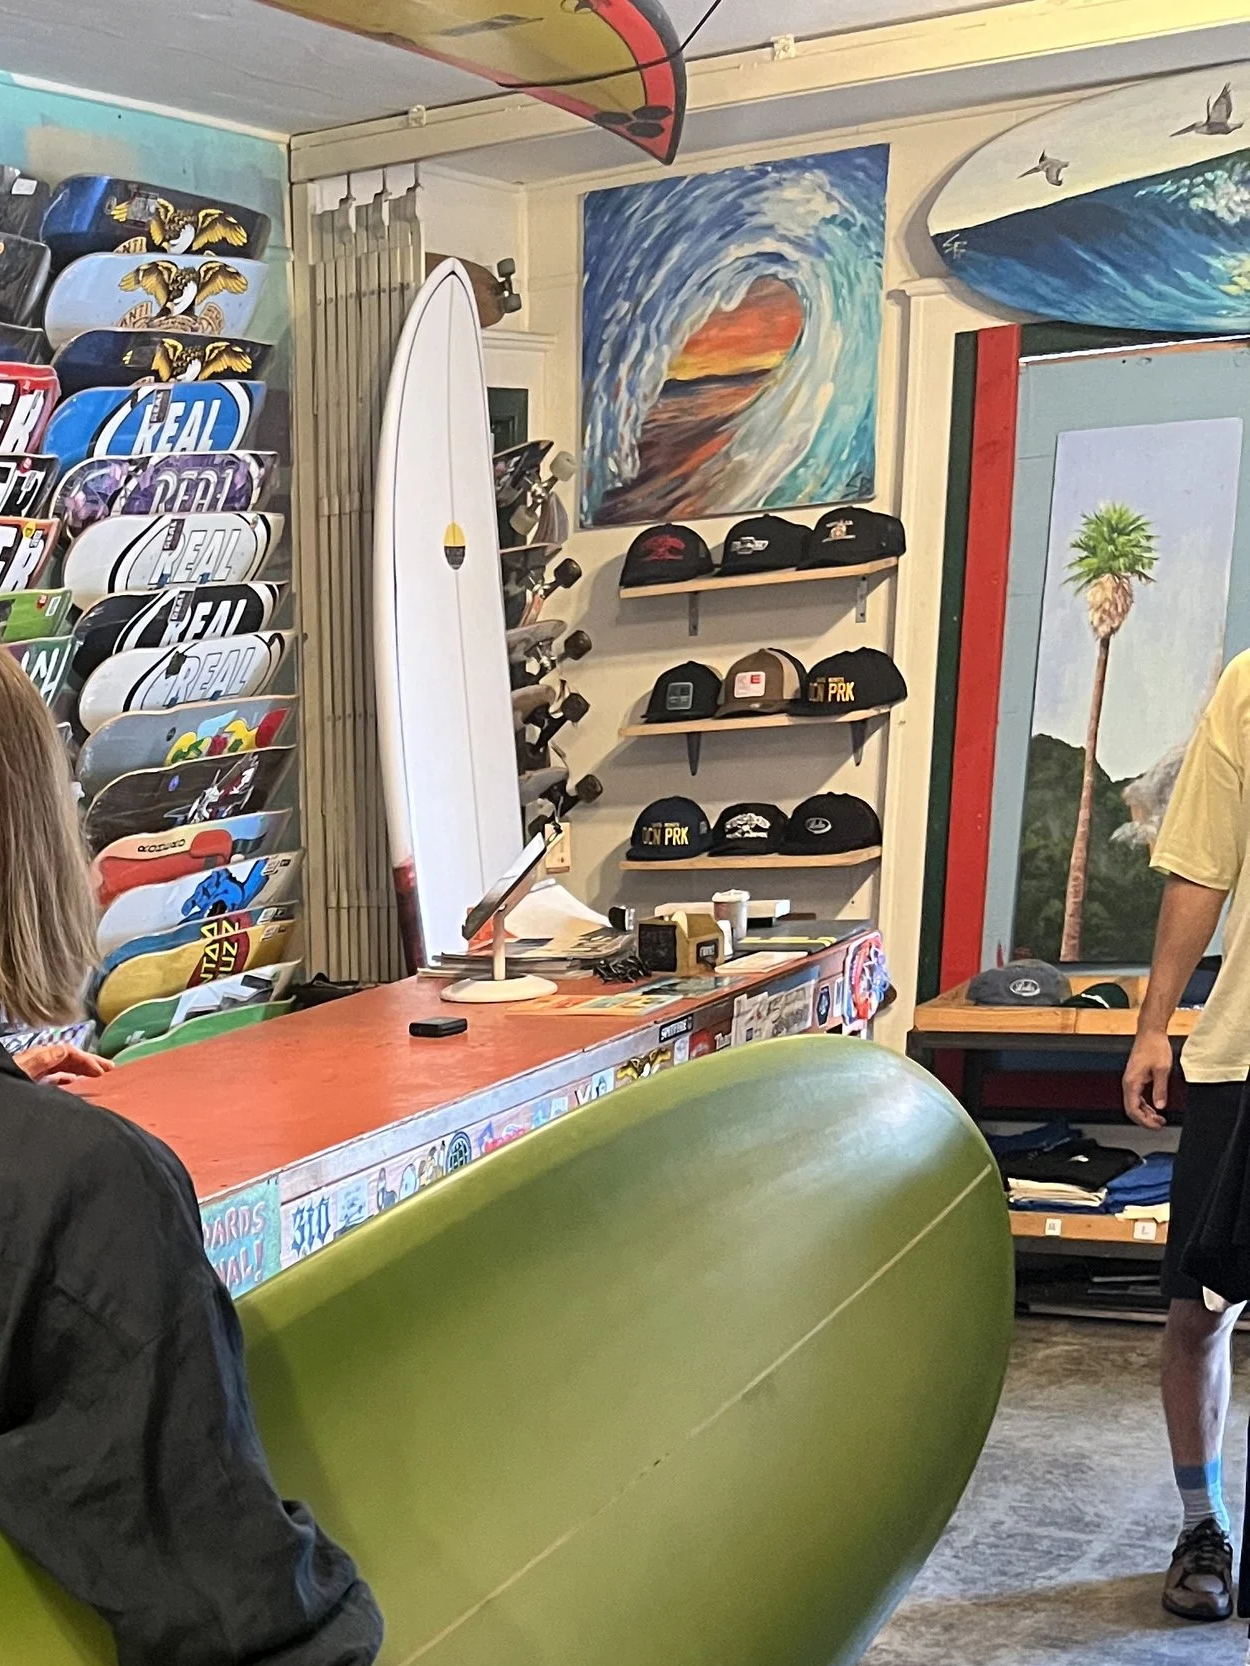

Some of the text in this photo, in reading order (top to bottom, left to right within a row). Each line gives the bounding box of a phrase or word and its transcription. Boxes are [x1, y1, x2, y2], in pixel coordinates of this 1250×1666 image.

[132, 400, 221, 454] REAL
[151, 468, 235, 512] REAL
[147, 529, 242, 585] REAL
[158, 598, 249, 648] REAL
[165, 647, 255, 707] REAL
[828, 681, 855, 702] PRK
[664, 826, 689, 846] PRK
